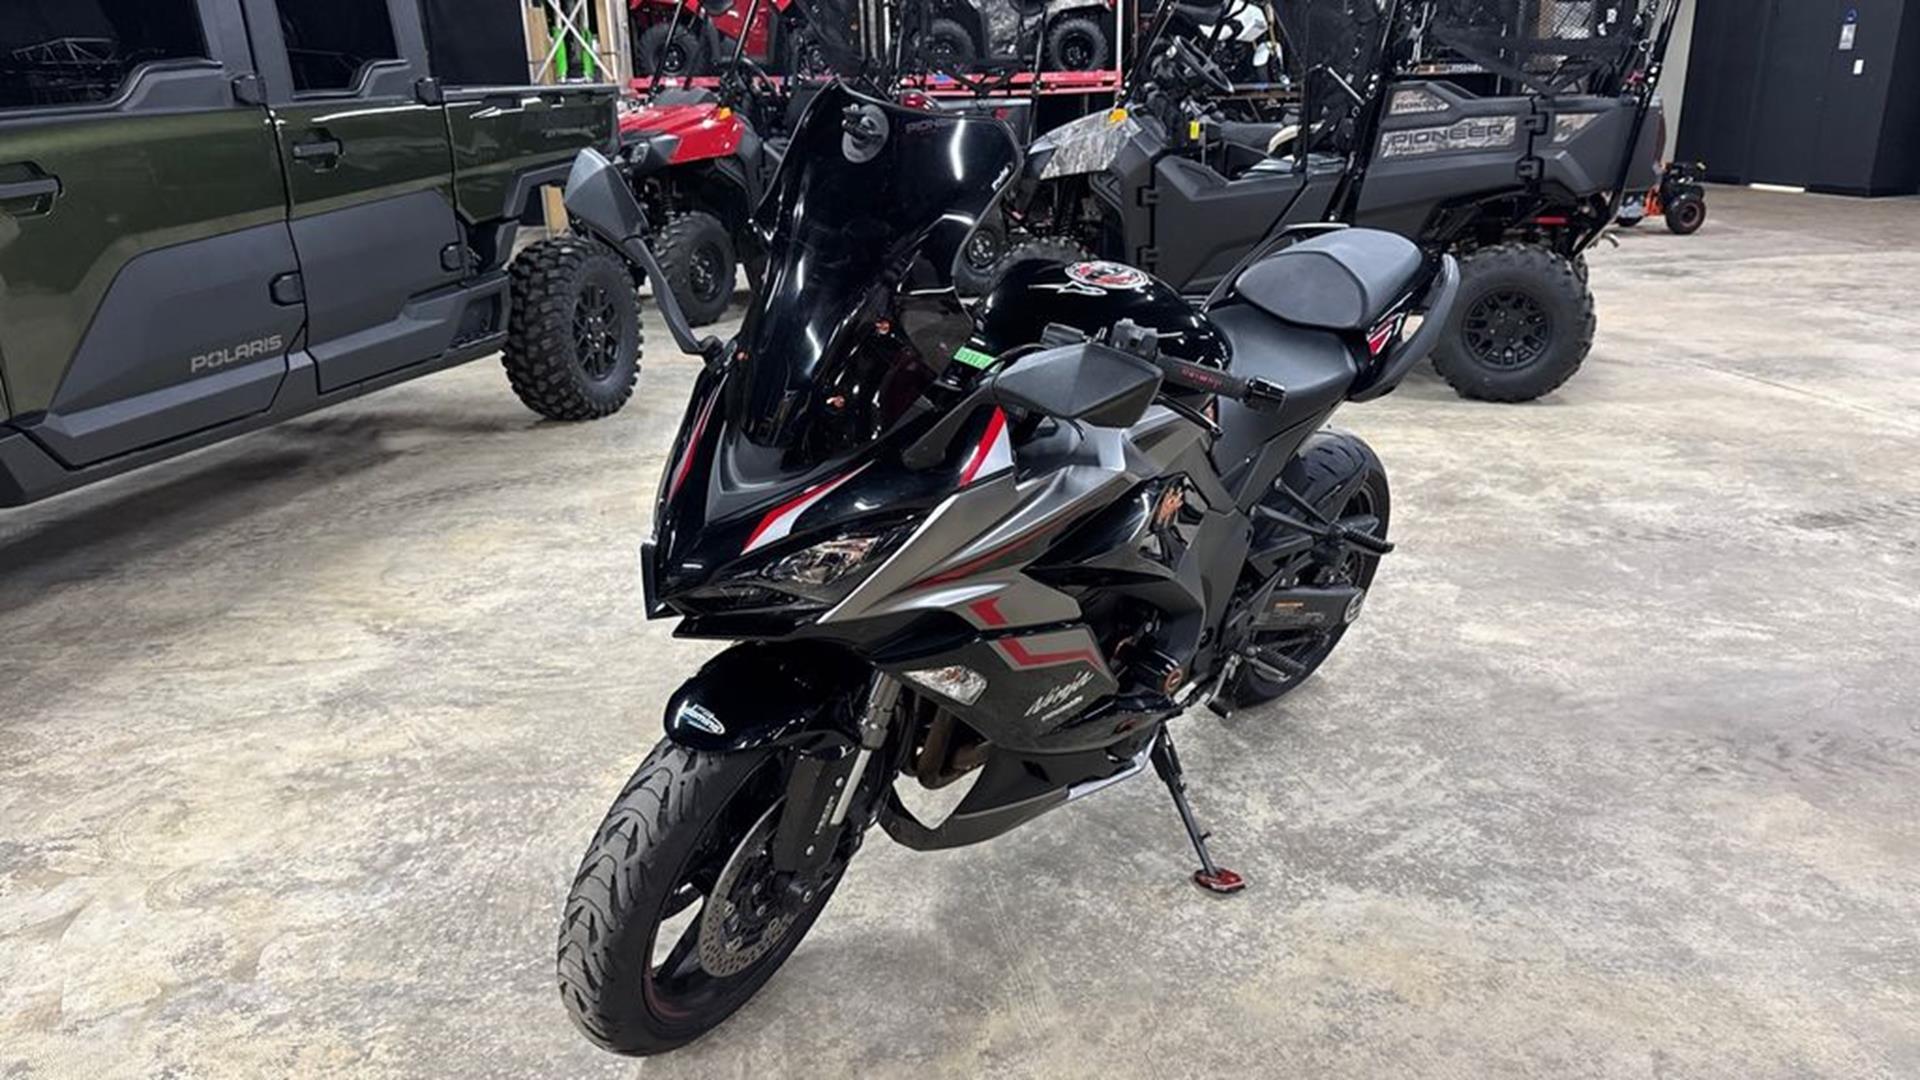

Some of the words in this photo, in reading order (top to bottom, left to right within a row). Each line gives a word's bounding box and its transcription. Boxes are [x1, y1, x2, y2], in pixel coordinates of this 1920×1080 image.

[1391, 124, 1504, 146] PIONEER
[191, 334, 283, 373] POLARIS
[1023, 671, 1095, 717] Ninja
